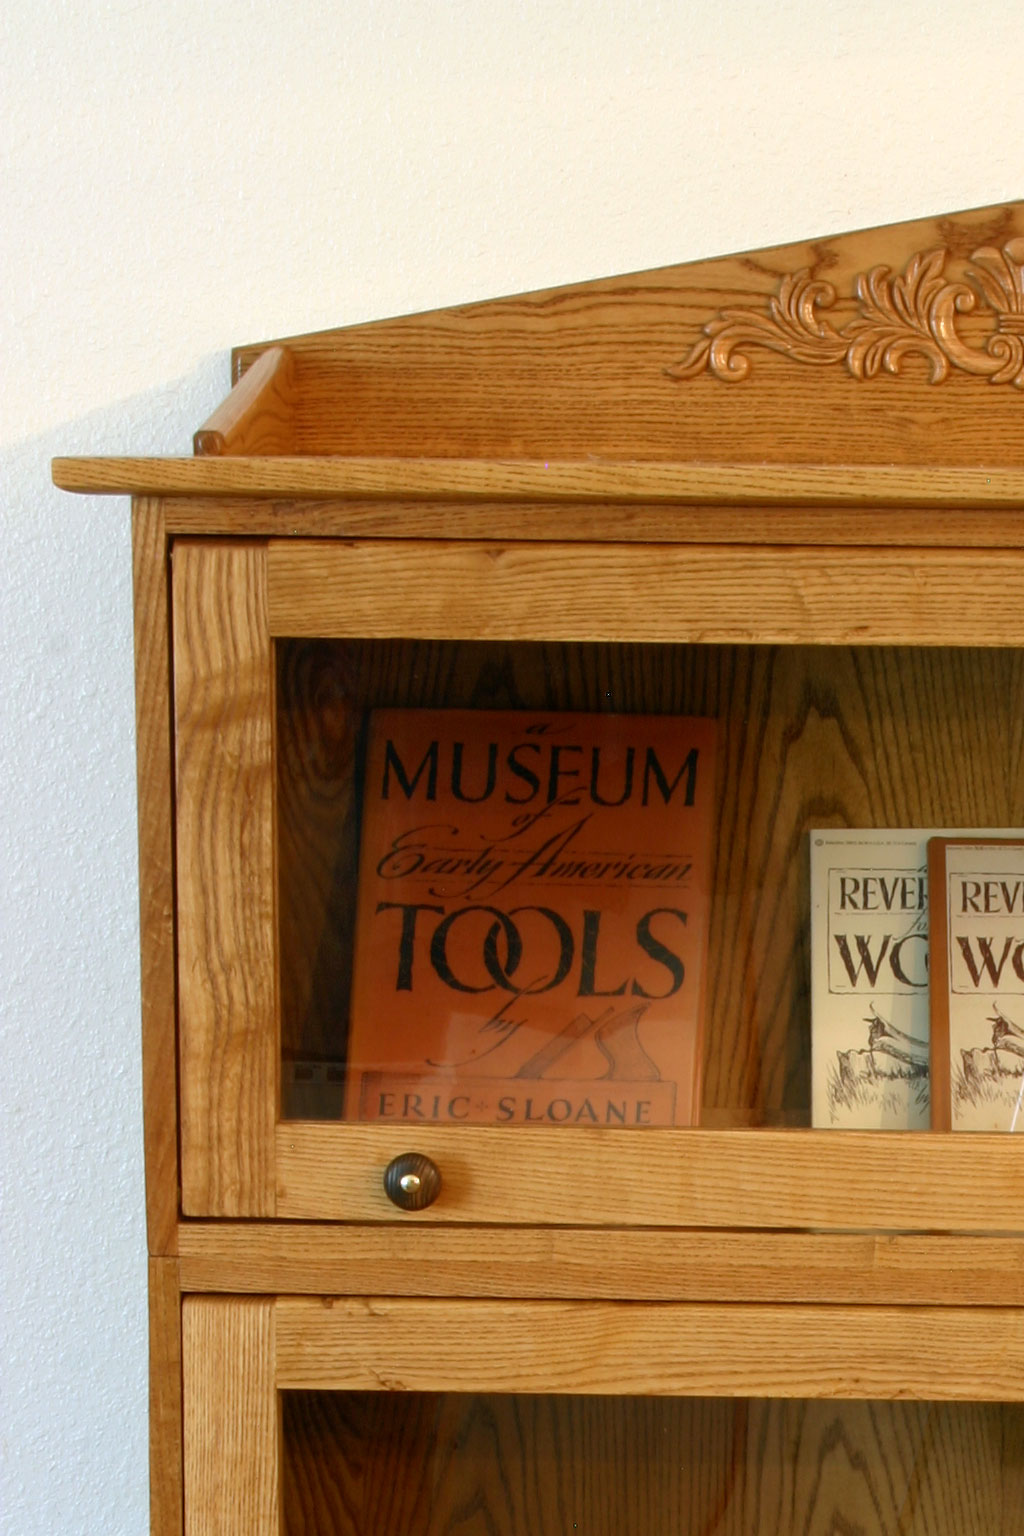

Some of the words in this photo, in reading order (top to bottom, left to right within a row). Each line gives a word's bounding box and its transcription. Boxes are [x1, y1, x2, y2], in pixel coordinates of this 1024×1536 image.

[526, 722, 576, 735] a
[380, 740, 699, 807] MUSEUM
[480, 786, 588, 842] of
[376, 824, 506, 898] Early
[464, 811, 693, 900] American
[375, 902, 689, 1000] TOOLS
[425, 975, 549, 1068] by
[378, 1093, 471, 1121] ERIC
[496, 1096, 652, 1124] SLOANE
